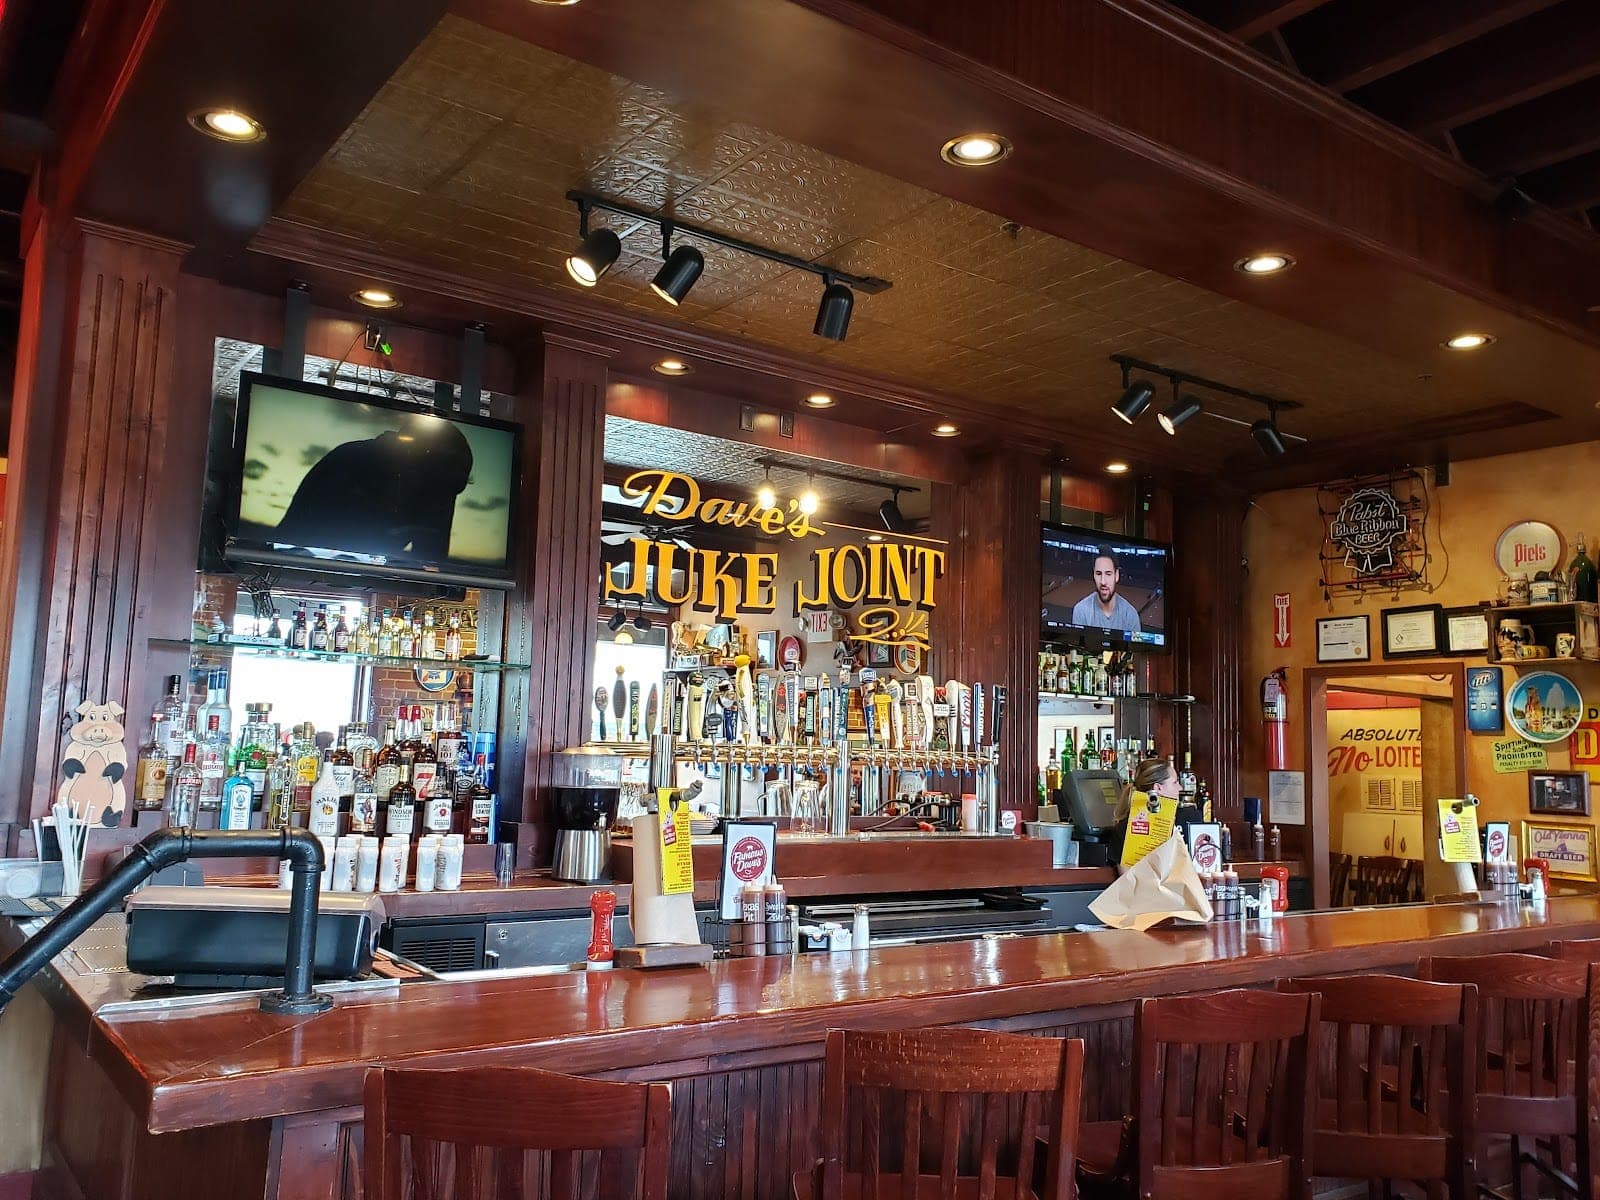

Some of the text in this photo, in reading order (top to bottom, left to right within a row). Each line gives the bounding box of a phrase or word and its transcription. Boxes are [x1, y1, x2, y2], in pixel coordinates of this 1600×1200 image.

[622, 469, 826, 537] Dave's
[1348, 501, 1388, 521] Pabst
[1335, 518, 1399, 536] Blue Ribbon
[1355, 532, 1380, 544] BEER
[604, 537, 945, 622] JUKE JOINT
[1327, 746, 1373, 777] No
[416, 772, 434, 799] 7
[1535, 831, 1552, 843] Old
[734, 849, 763, 864] Famous
